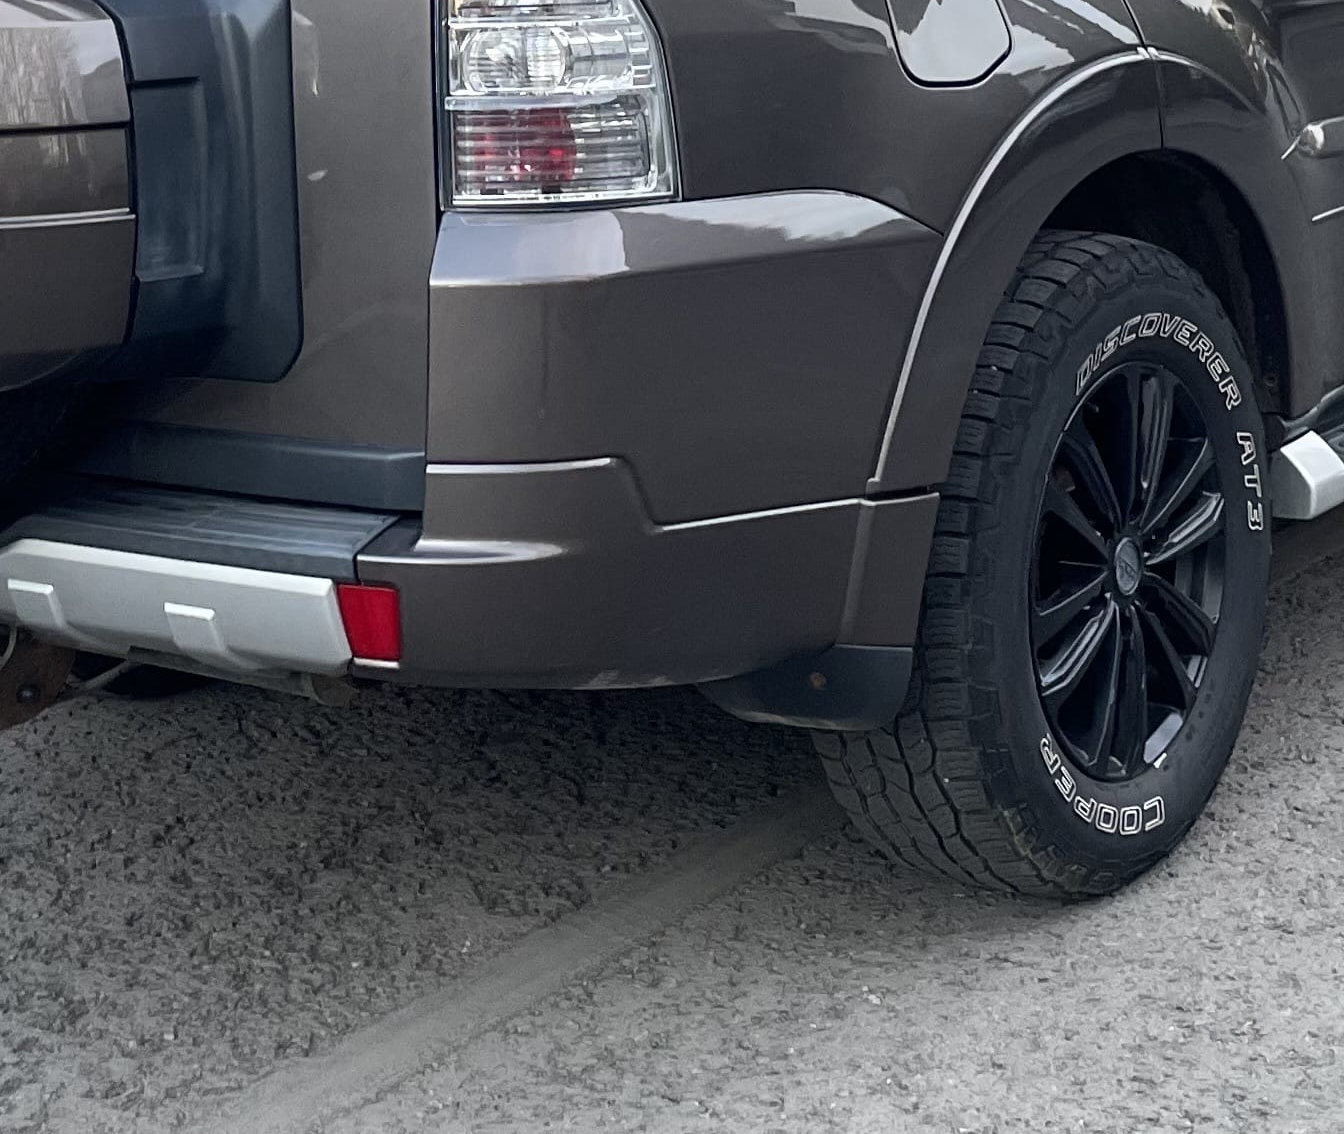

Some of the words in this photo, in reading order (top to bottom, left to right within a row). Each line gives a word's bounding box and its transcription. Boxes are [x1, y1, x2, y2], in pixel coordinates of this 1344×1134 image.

[1075, 312, 1243, 411] DISCOVERER
[1236, 431, 1264, 531] AT3
[1040, 732, 1166, 836] COOPER
